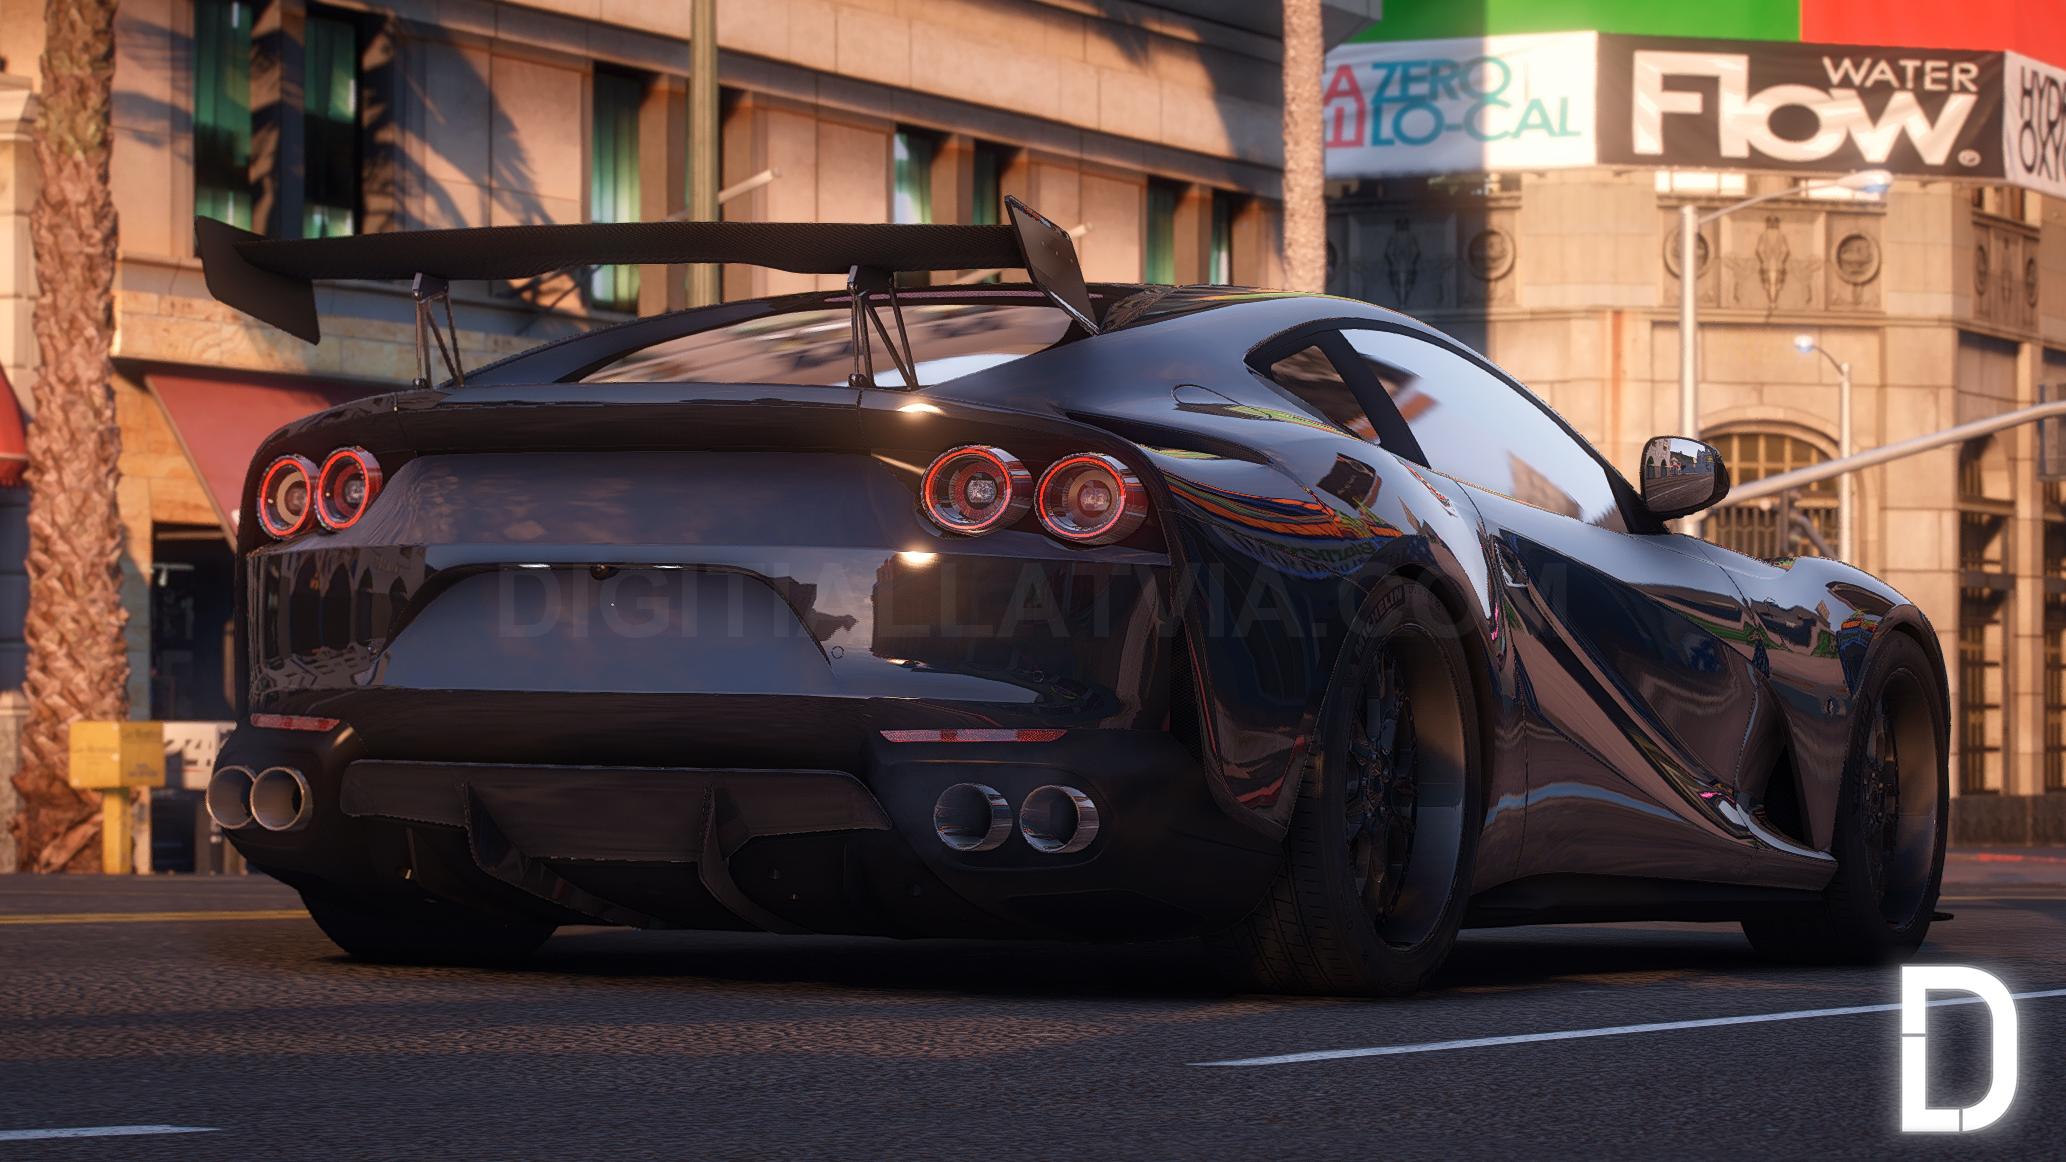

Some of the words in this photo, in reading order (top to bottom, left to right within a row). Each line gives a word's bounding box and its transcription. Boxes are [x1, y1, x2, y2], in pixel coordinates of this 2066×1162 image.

[1370, 56, 1512, 103] ZERO
[1822, 56, 1978, 92] WATER
[2020, 65, 2066, 128] HYD
[1371, 97, 1582, 146] LO-CAL
[2019, 119, 2066, 182] OXY
